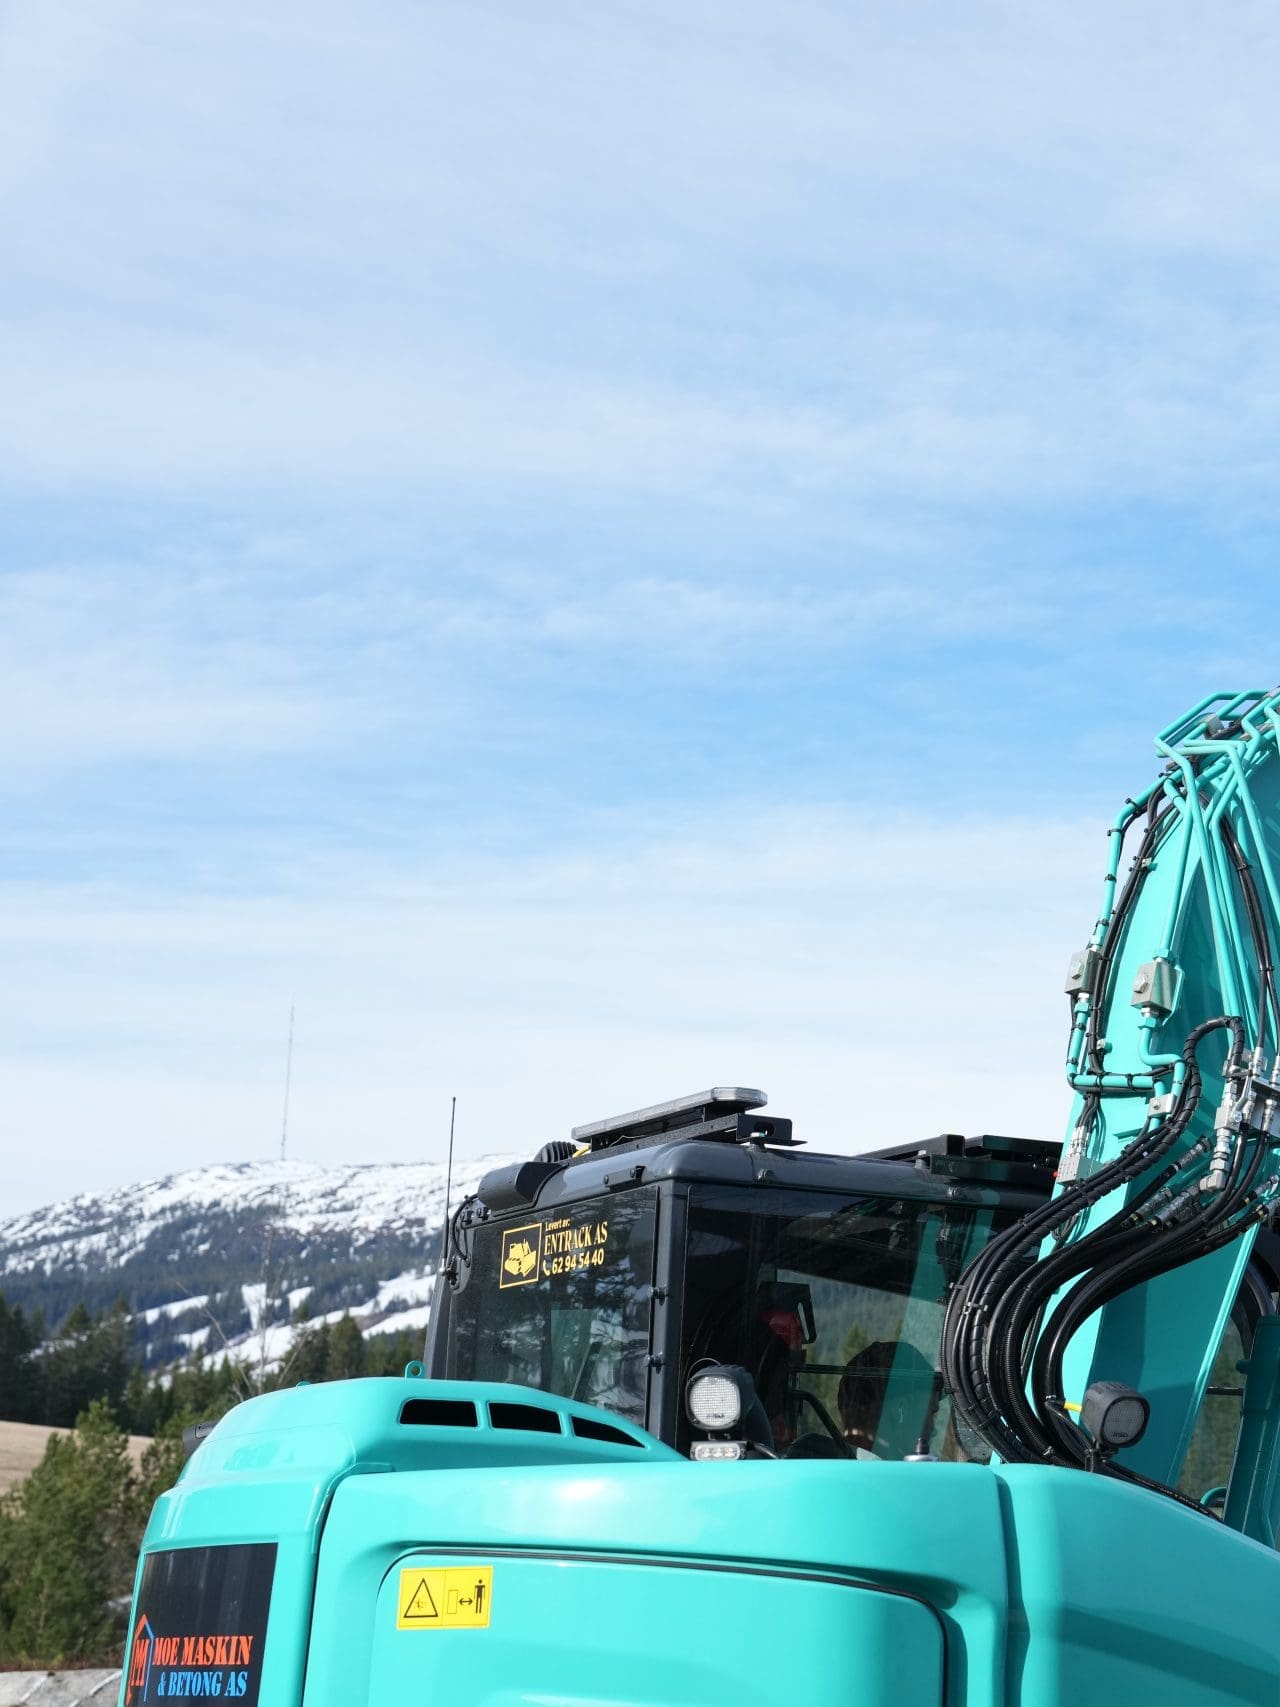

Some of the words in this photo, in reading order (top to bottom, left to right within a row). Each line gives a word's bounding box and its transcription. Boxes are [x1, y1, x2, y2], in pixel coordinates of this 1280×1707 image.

[544, 1225, 592, 1255] ENTRACK
[594, 1221, 608, 1244] AS
[545, 1219, 562, 1231] Levert
[552, 1257, 563, 1274] 62
[565, 1254, 576, 1271] 94
[578, 1251, 590, 1268] 54
[591, 1248, 604, 1265] 40
[152, 1636, 180, 1666] MOE
[180, 1635, 253, 1666] MASKIN
[157, 1671, 167, 1697] &
[167, 1671, 223, 1697] BETONG
[224, 1671, 248, 1697] AS
